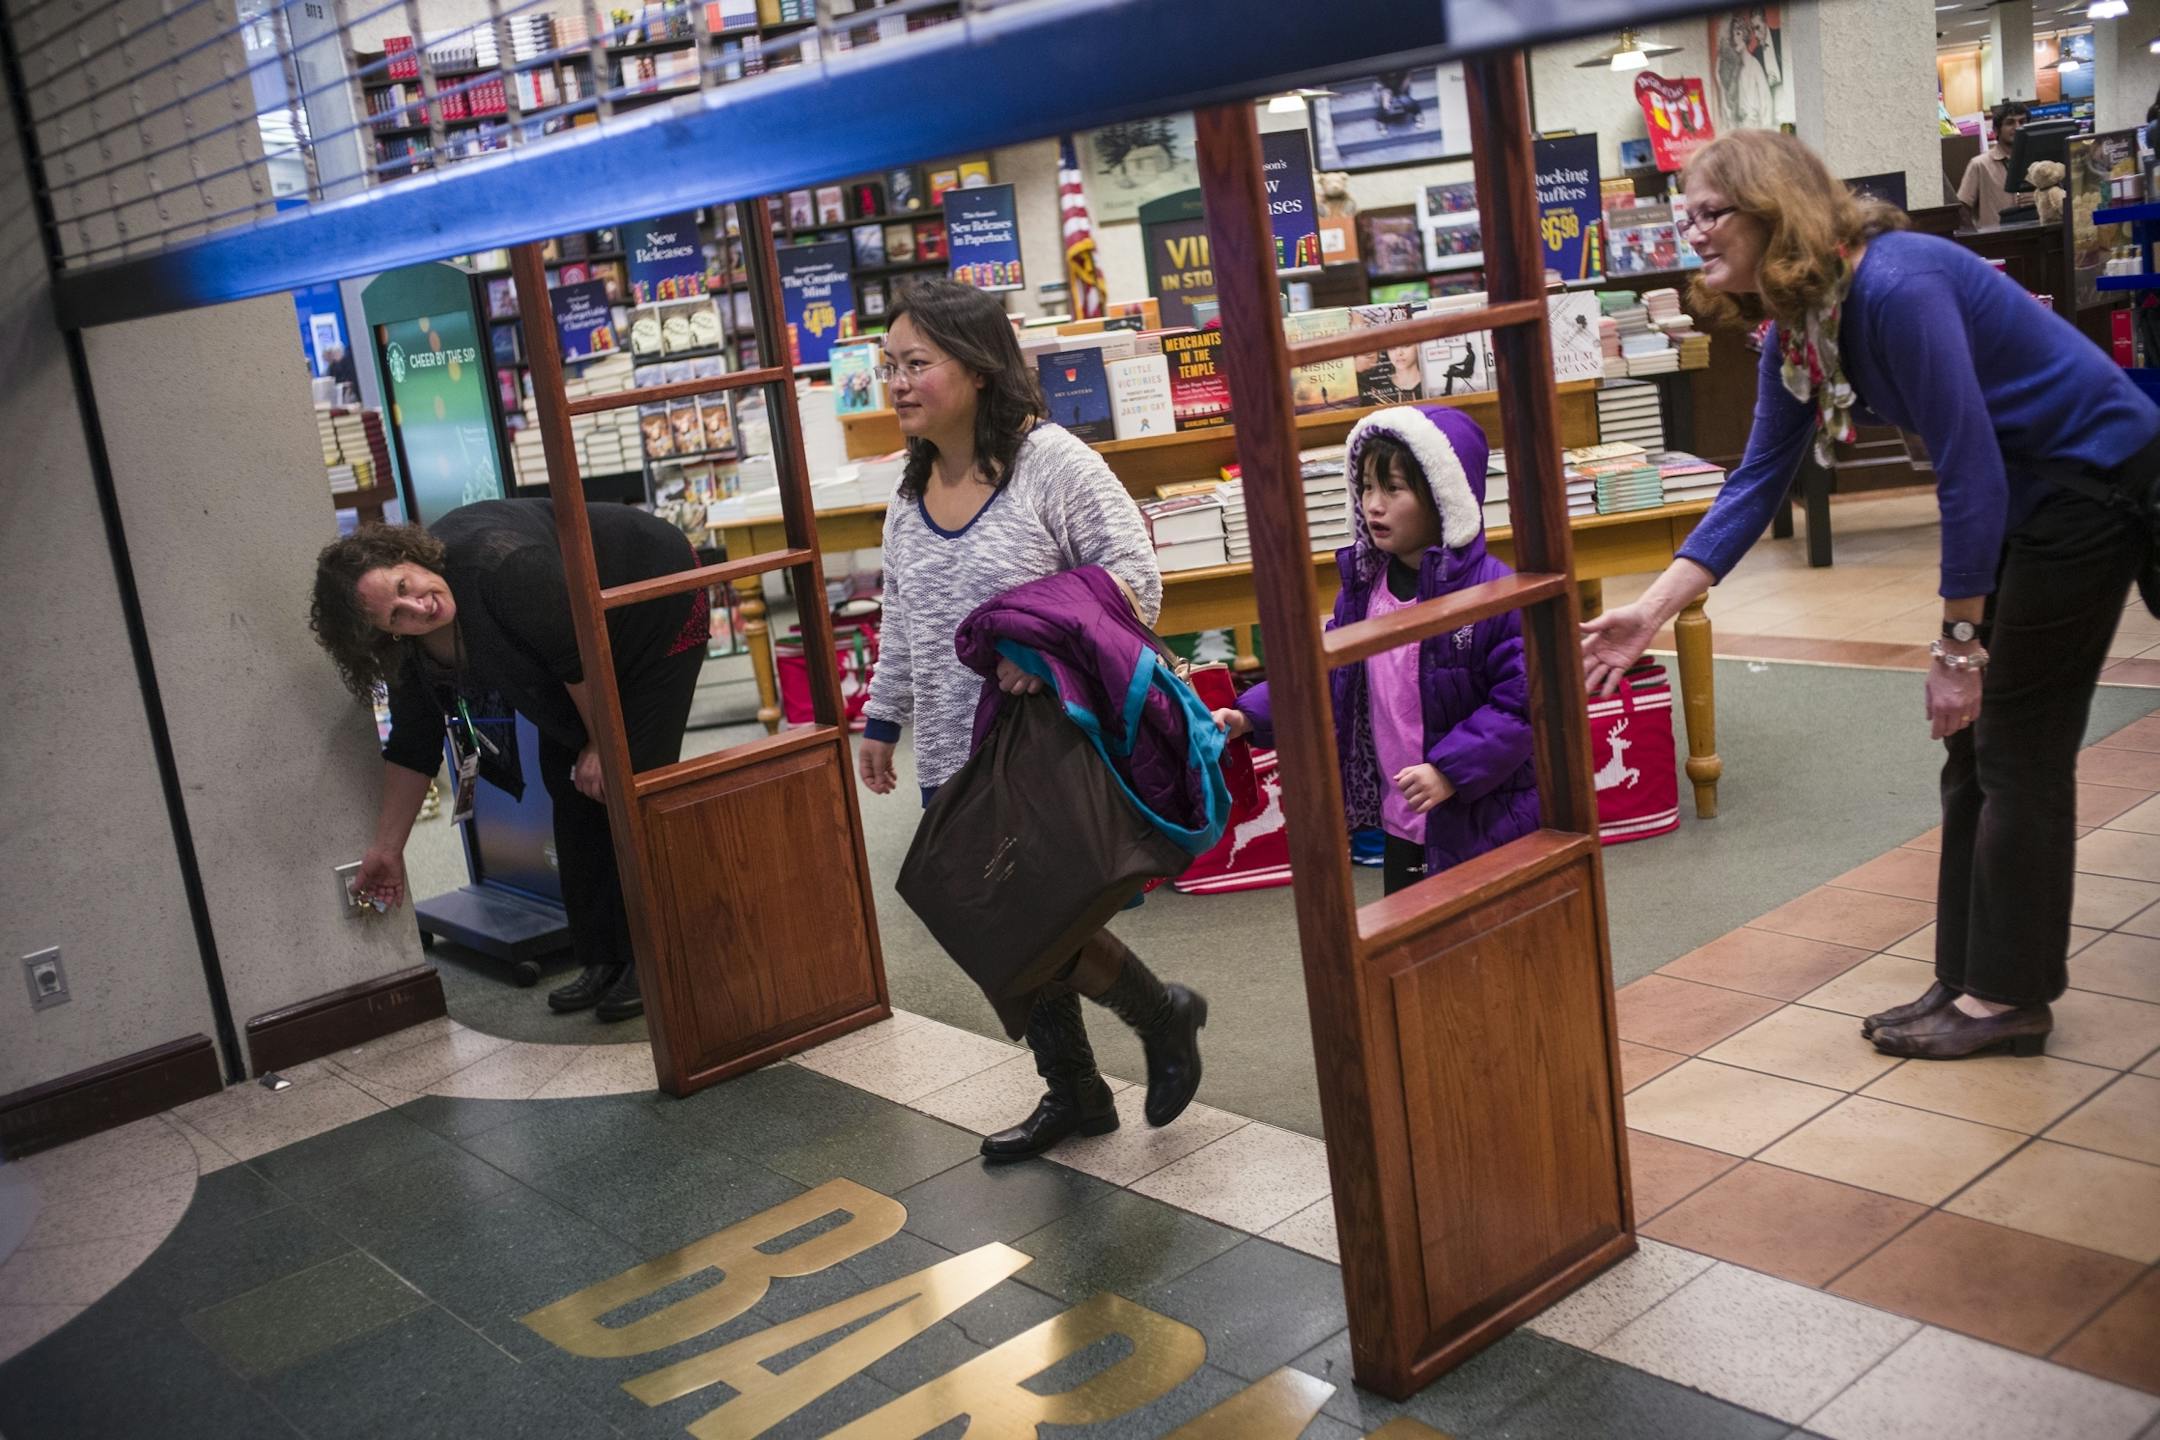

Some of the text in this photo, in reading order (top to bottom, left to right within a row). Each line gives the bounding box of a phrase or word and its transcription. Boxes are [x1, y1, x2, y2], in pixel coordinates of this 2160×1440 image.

[1262, 160, 1288, 170] son's
[1535, 167, 1589, 186] tocking
[949, 220, 1012, 234] New Releases
[645, 231, 677, 247] New
[953, 231, 1012, 246] in Paperback
[635, 246, 694, 263] Releases
[781, 272, 848, 289] The Creative
[1161, 270, 1213, 291] IN STO
[802, 285, 831, 298] Mind
[1165, 332, 1222, 352] MERCHANTS
[409, 347, 476, 369] CHEER BY THE SIP
[1180, 348, 1211, 364] IN THE
[1122, 363, 1152, 376] LITTLE
[1178, 361, 1216, 378] TEMPLE
[1300, 359, 1344, 373] RISING
[1117, 374, 1162, 389] VICTORIES
[1310, 372, 1336, 384] SUN
[1120, 400, 1166, 417] JASON GAY
[519, 1177, 1440, 1440] BAR
